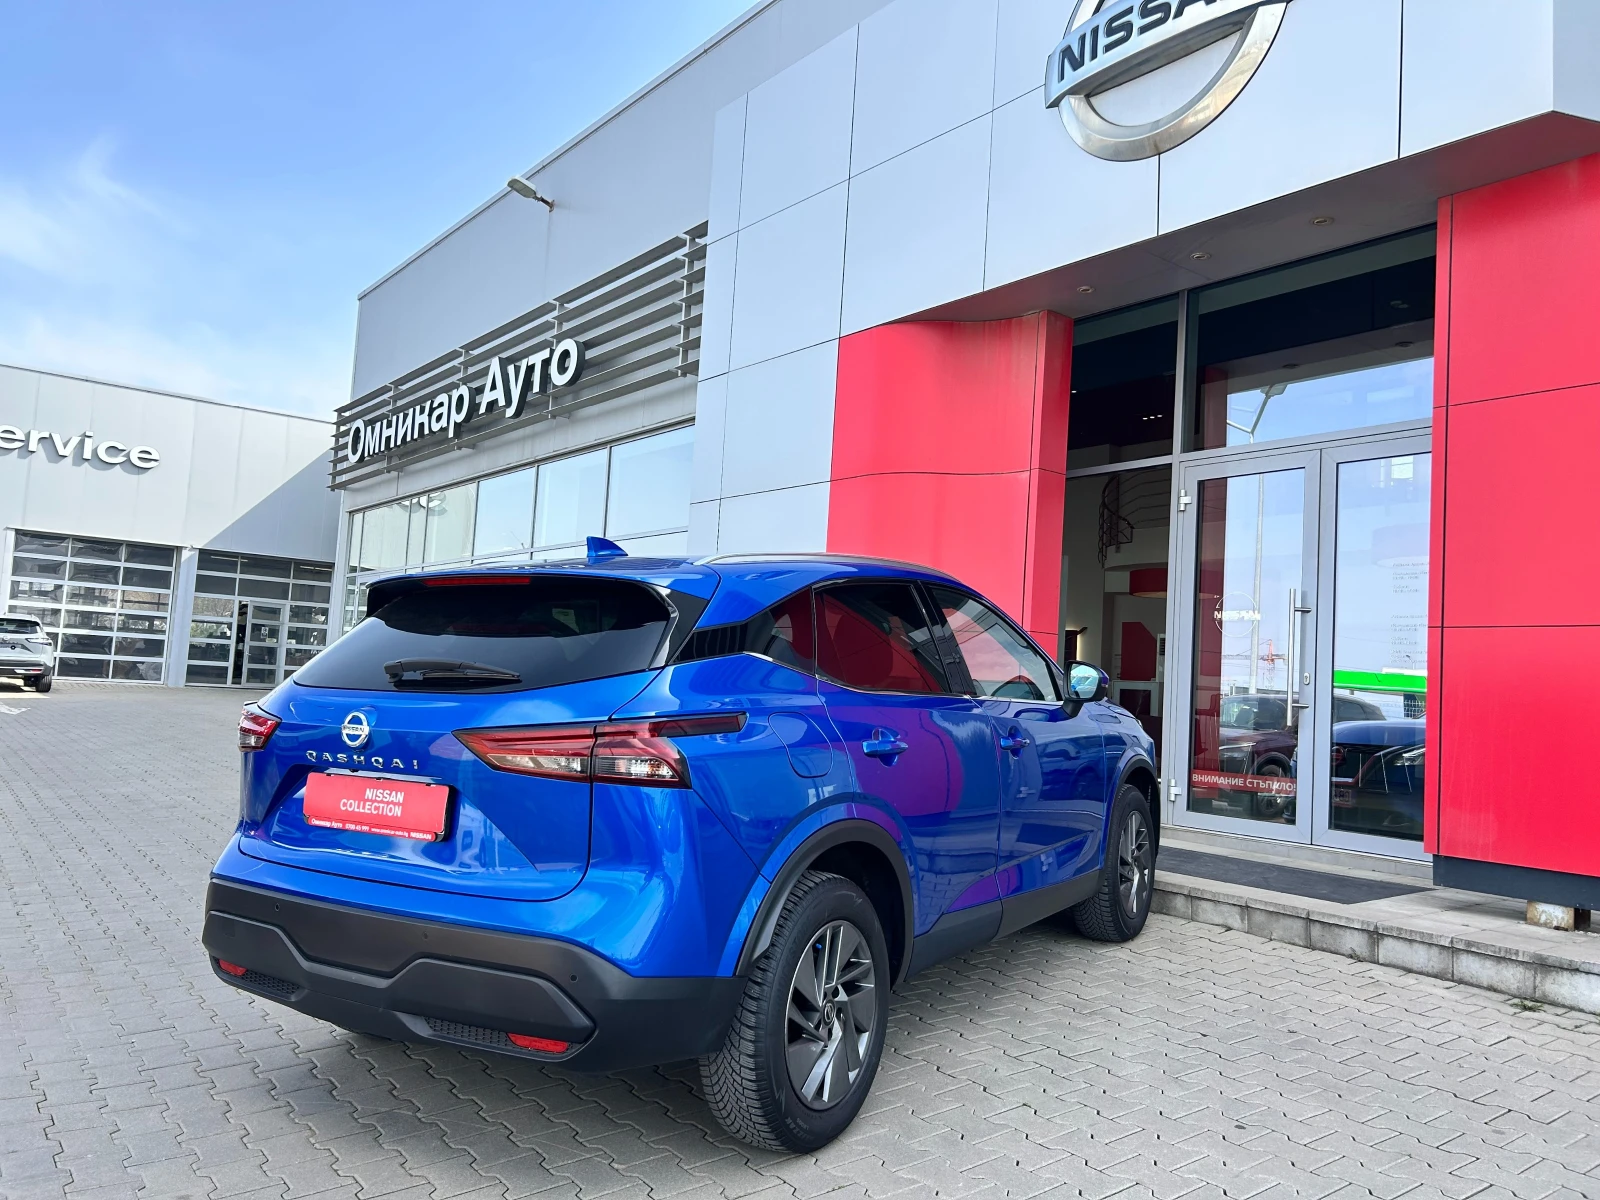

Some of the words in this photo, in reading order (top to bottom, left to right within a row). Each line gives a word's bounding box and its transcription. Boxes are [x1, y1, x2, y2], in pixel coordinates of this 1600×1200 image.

[1058, 0, 1225, 83] NISS
[348, 385, 475, 464] Омникар
[479, 338, 584, 419] Ауто
[306, 750, 418, 769] QASHQAI
[1192, 773, 1244, 786] ВНИМАНИЕ
[365, 788, 404, 803] NISSAN
[340, 799, 402, 816] COLLECTION
[410, 831, 432, 840] NISSAN
